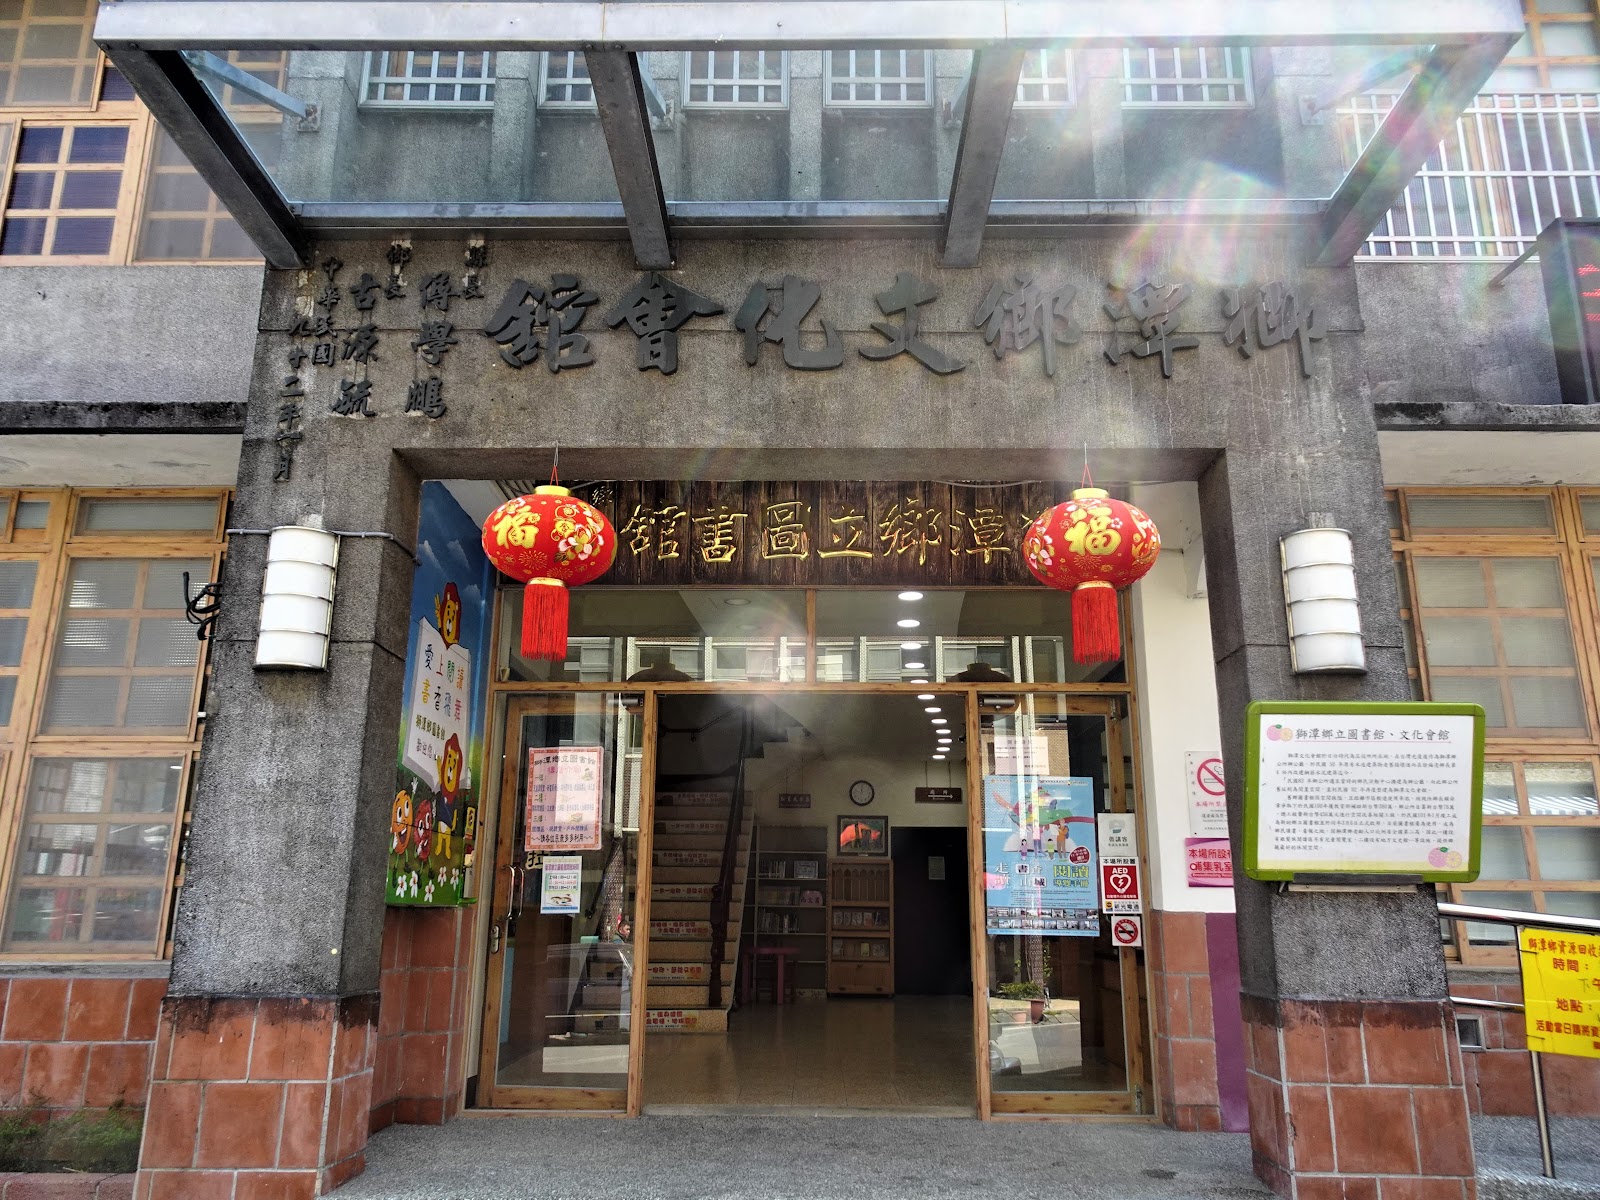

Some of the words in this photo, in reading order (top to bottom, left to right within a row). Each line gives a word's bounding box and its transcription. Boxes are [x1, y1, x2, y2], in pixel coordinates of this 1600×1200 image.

[620, 498, 1036, 566] 潭鄉立圖書館
[1063, 506, 1122, 557] 福
[1295, 727, 1450, 741] 獅潭鄉立圖書館、文化會館
[1111, 867, 1129, 875] AED
[1527, 936, 1600, 960] 獅潭鄉資源回收
